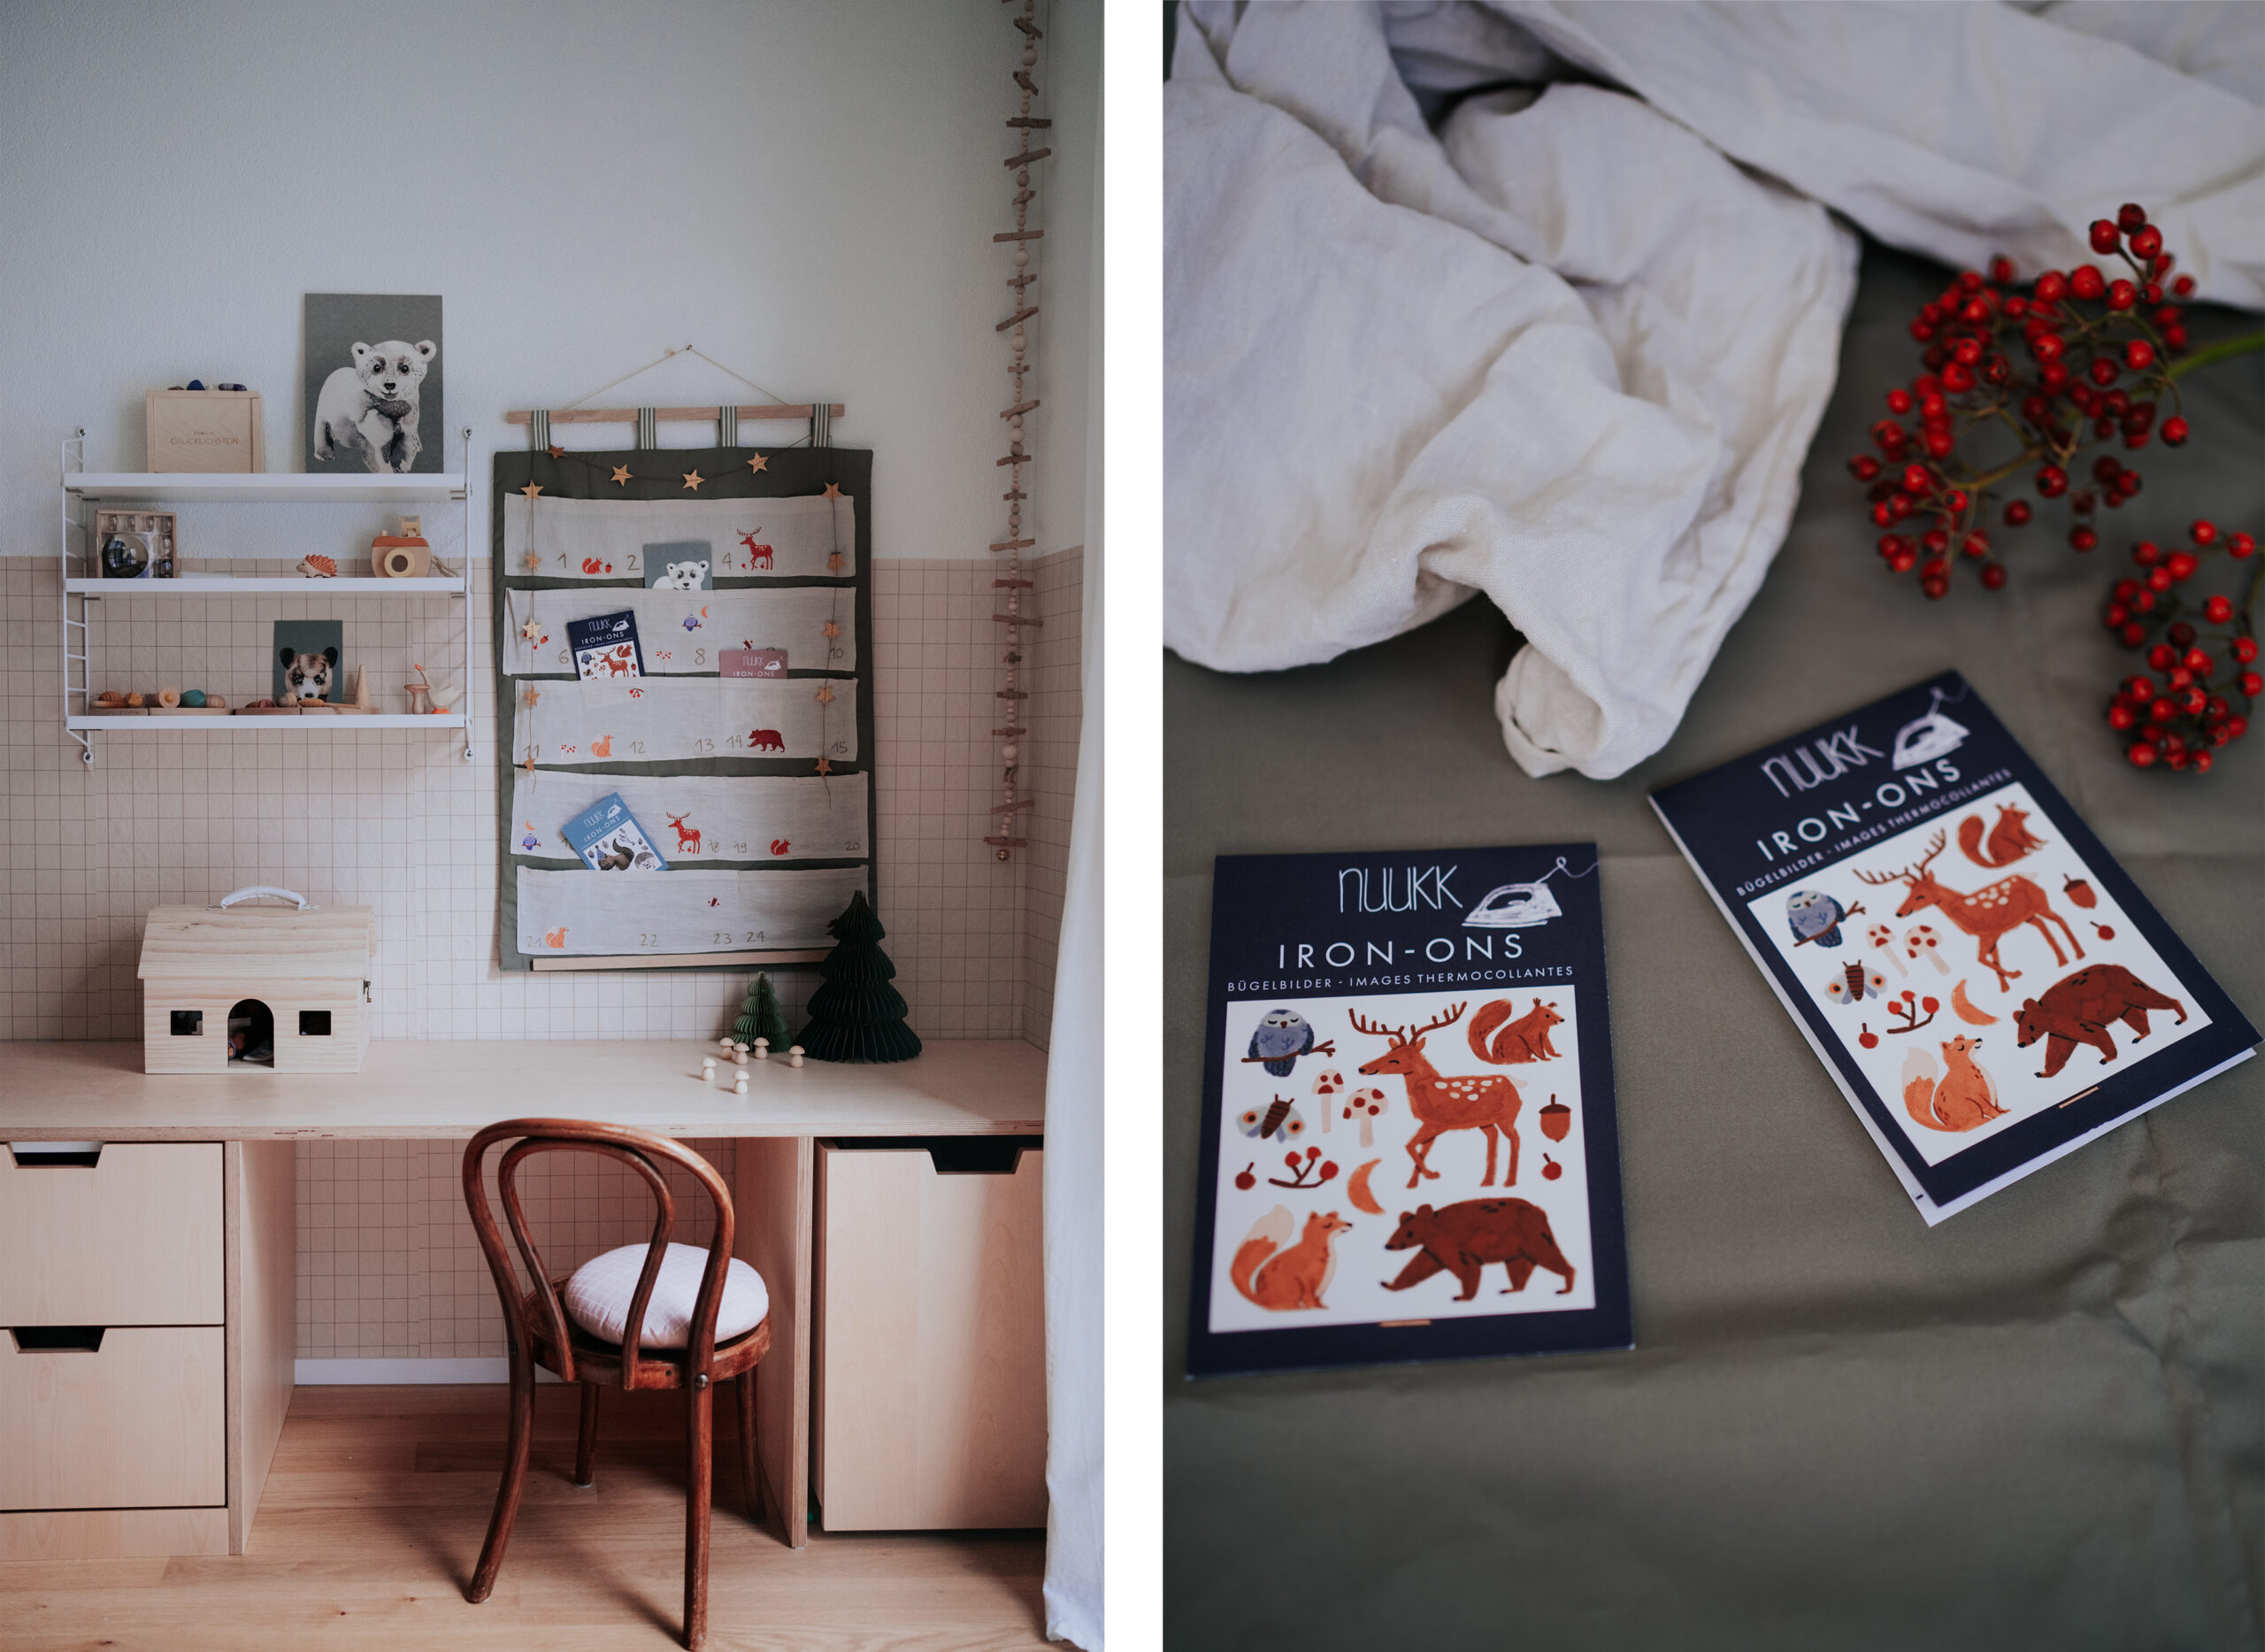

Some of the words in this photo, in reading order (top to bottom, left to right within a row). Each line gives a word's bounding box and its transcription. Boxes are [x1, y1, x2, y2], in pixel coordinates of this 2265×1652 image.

[557, 553, 567, 569] 1
[626, 554, 641, 571] 2
[721, 552, 732, 570] 4
[581, 631, 625, 645] IRON-ONS
[558, 649, 570, 665] 6
[695, 648, 706, 665] 8
[829, 647, 844, 659] 10
[630, 741, 647, 754] 12
[695, 738, 715, 752] 13
[831, 741, 848, 754] 15
[1756, 758, 1962, 862] IRON-ONS
[584, 815, 620, 842] IRON-ONS
[1736, 851, 1824, 896] BÜGELBILDER
[1834, 823, 1887, 852] IMAGES
[1887, 767, 2013, 828] THERMOCOLLANTES
[708, 841, 720, 854] 18
[733, 841, 748, 854] 19
[845, 841, 861, 851] 20
[640, 934, 659, 947] 22
[713, 933, 733, 944] 23
[746, 930, 766, 943] 24
[1279, 934, 1523, 969] IRON-ONS
[1228, 978, 1332, 992] BÜGELBILDER
[1349, 974, 1411, 987] IMAGES
[1417, 966, 1573, 983] THERMOCOLLANTES
